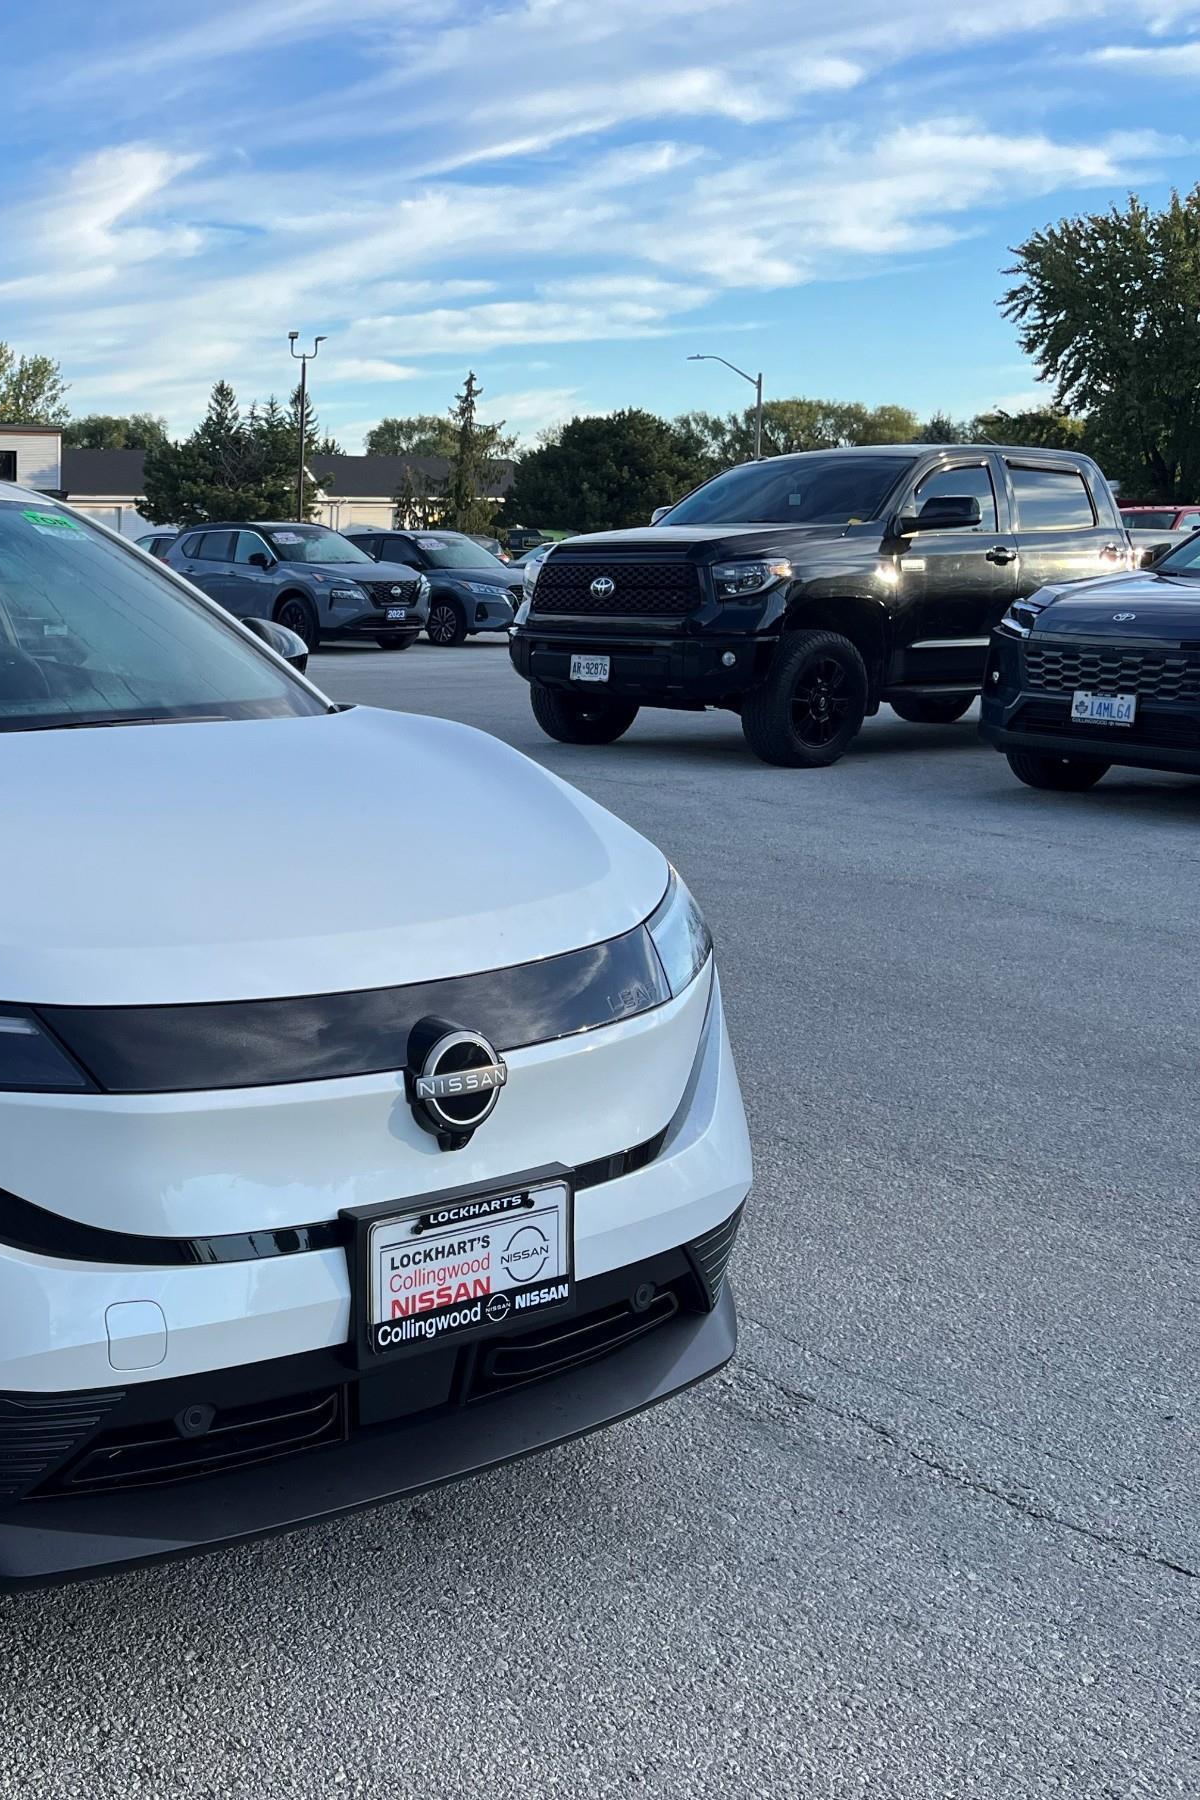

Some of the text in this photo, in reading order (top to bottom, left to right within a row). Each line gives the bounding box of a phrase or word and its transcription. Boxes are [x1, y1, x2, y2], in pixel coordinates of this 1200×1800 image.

[388, 610, 405, 618] 2023
[419, 1068, 505, 1096] NISSAN
[430, 1195, 522, 1223] LOCKHARTS
[390, 1235, 490, 1271] LOCKHART'S
[500, 1244, 549, 1264] NISSAN
[389, 1252, 490, 1293] Collingwood
[391, 1276, 491, 1320] NISSAN
[378, 1283, 569, 1346] Collingwood NISSAN NISSAN
